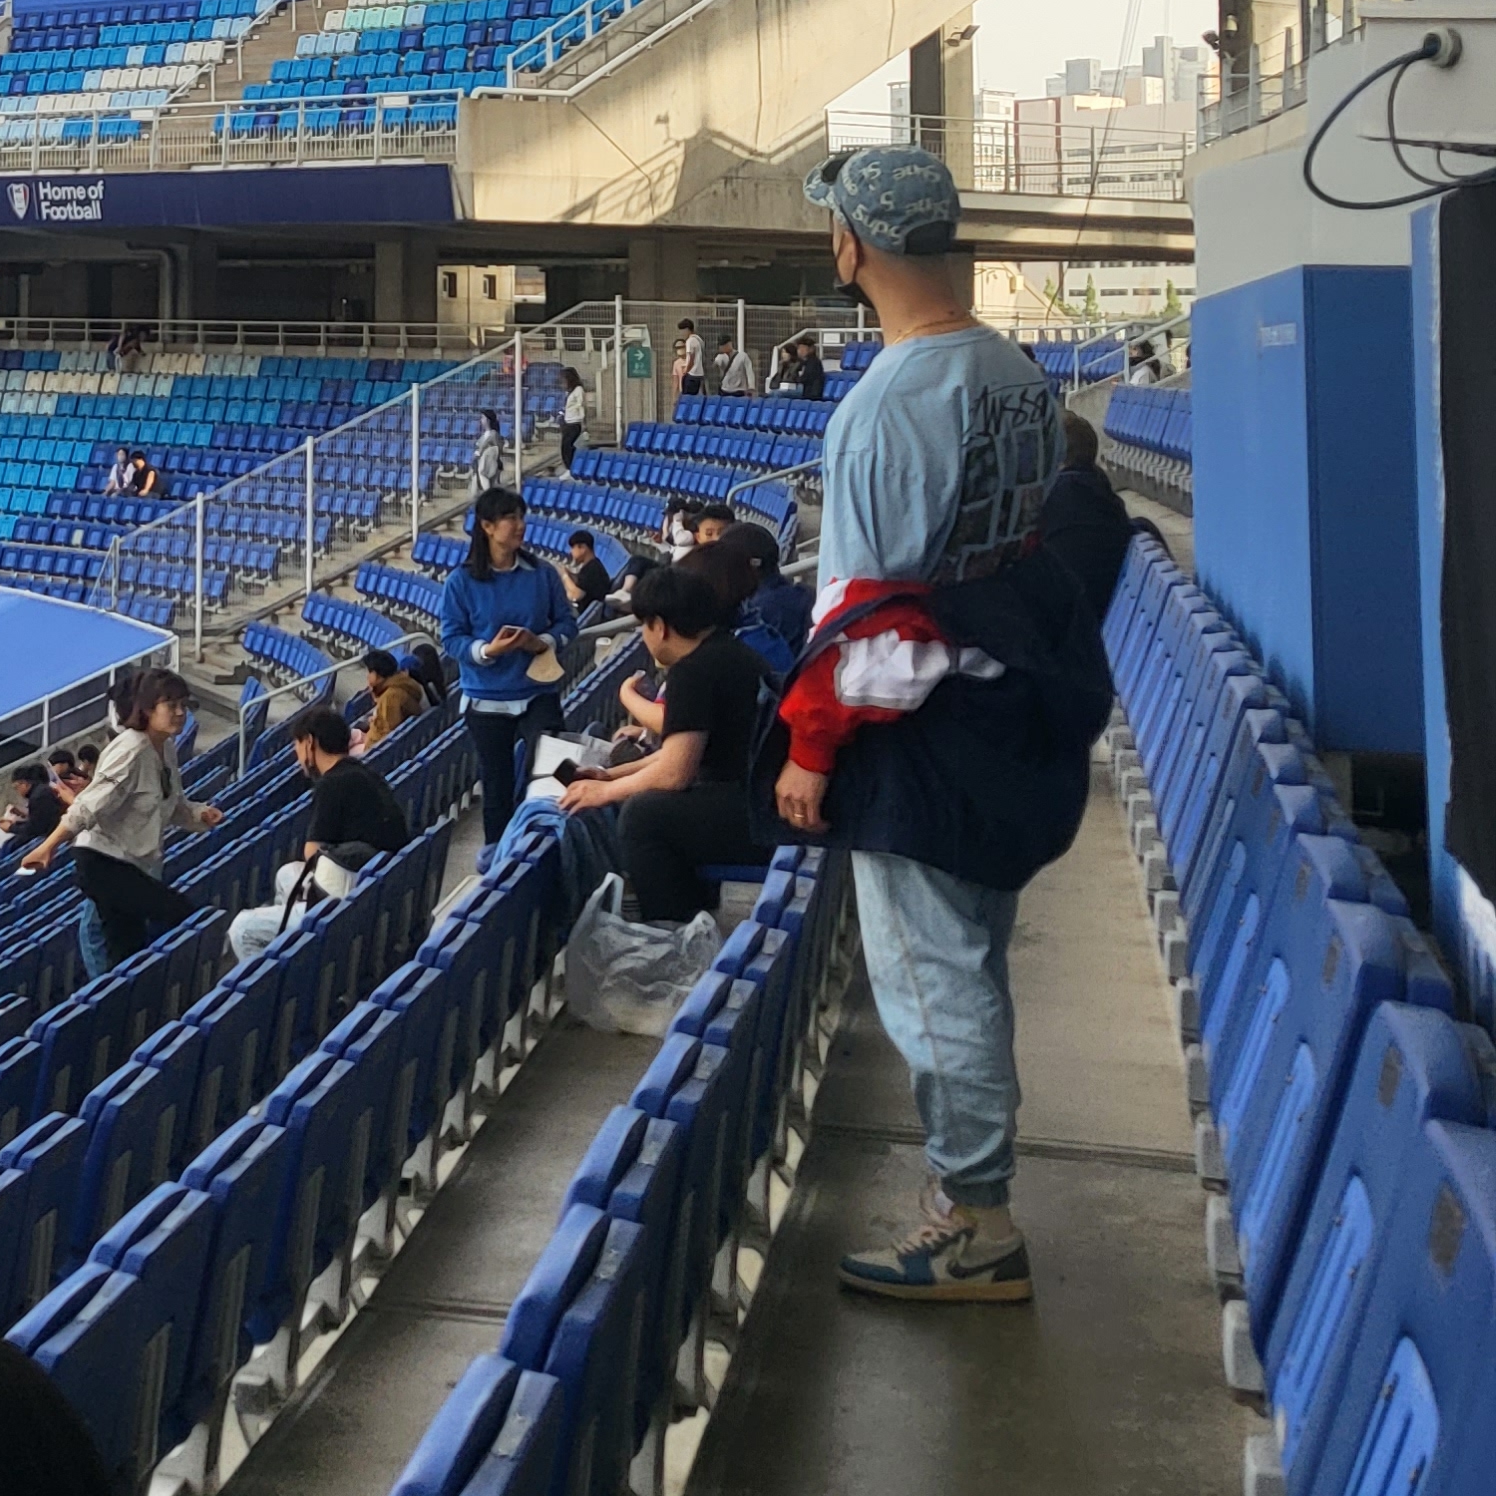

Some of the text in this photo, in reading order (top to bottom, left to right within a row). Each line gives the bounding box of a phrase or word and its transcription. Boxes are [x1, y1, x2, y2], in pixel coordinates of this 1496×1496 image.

[38, 180, 105, 200] Home of
[40, 200, 102, 220] Football
